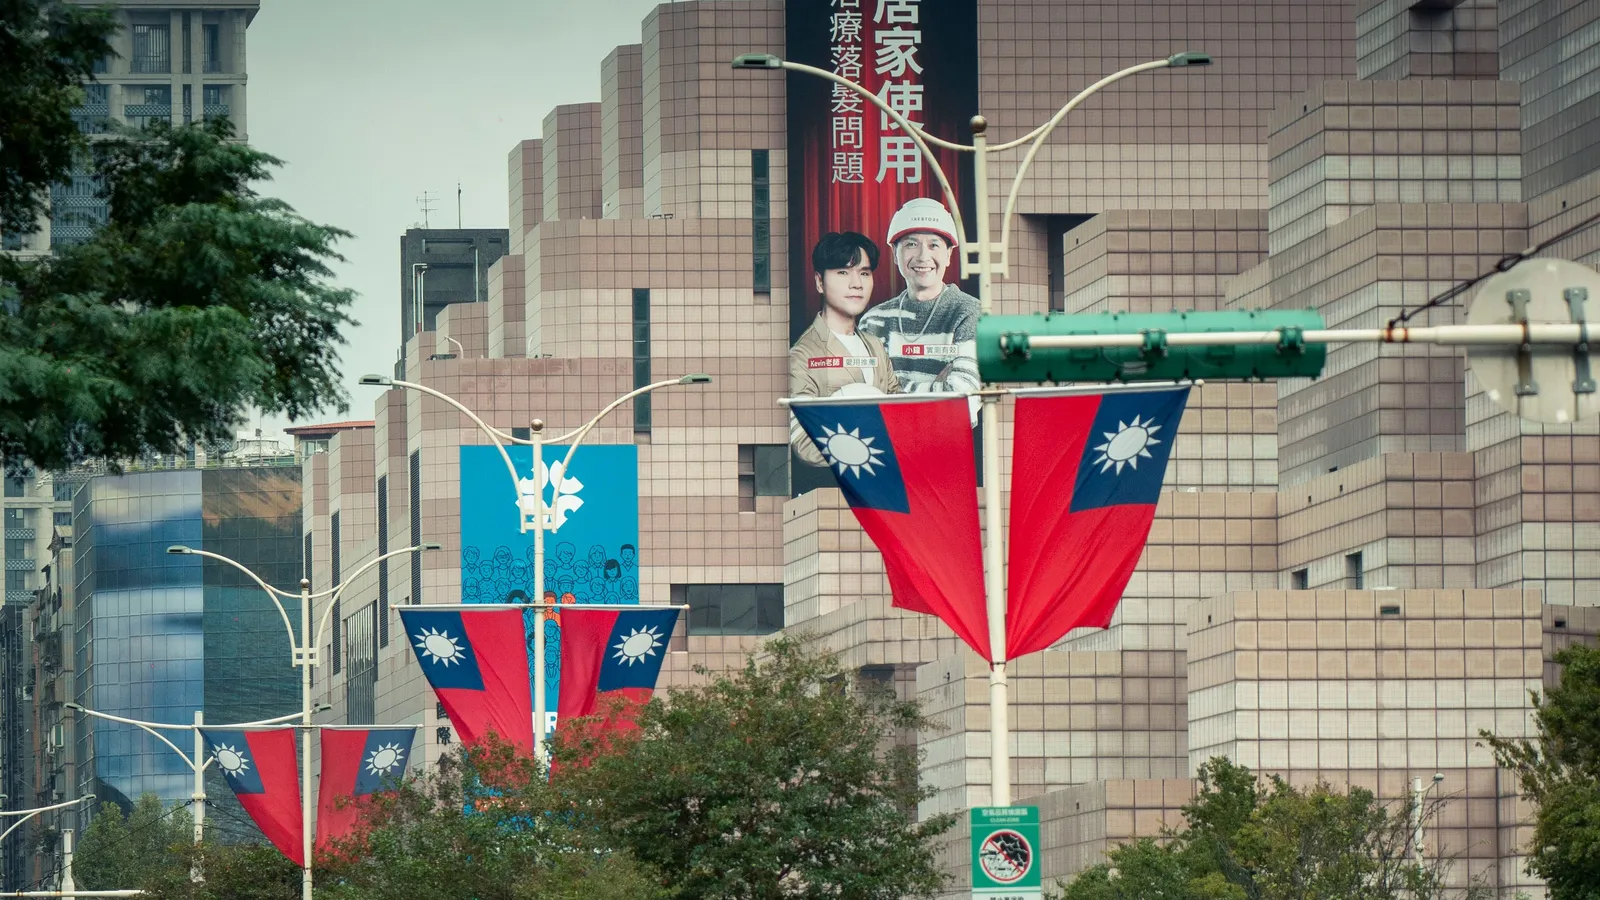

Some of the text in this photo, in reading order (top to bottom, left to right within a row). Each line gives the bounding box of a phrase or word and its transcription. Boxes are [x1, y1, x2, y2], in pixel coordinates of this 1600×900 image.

[830, 0, 865, 184] 療落髮問題
[810, 358, 840, 367] Kevin老師
